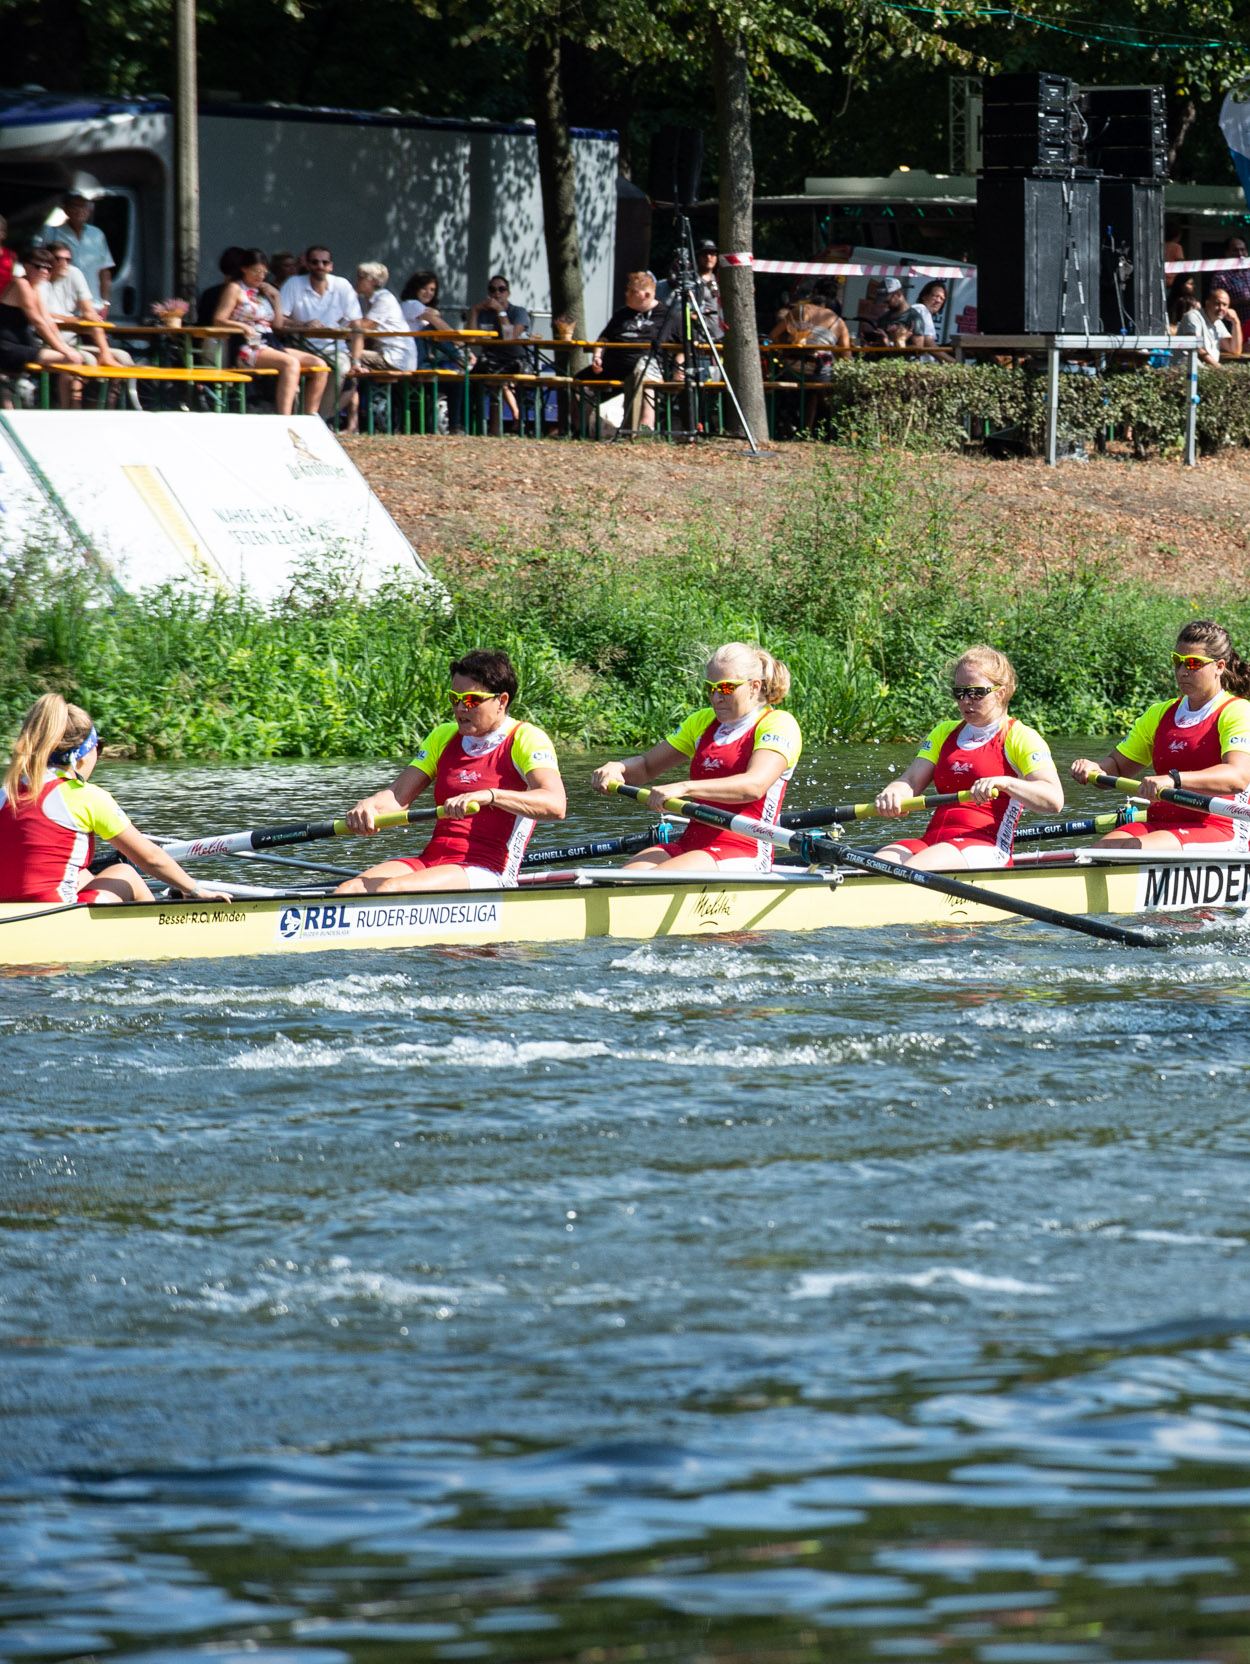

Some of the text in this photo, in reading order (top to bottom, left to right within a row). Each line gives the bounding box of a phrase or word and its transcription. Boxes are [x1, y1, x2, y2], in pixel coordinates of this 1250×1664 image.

[744, 822, 775, 839] Melitta
[1014, 826, 1042, 838] CHNELL.
[1045, 824, 1062, 834] GUT.
[186, 839, 230, 857] Melitta
[528, 849, 567, 862] SCHNELL.
[568, 846, 587, 857] GUT.
[845, 852, 865, 866] STARK.
[865, 858, 893, 874] SCHNELL.
[893, 866, 907, 878] GUT.
[693, 886, 731, 917] Melitta
[212, 911, 246, 923] Minden
[304, 904, 497, 930] RBL RUDER-BUNDESLIGA
